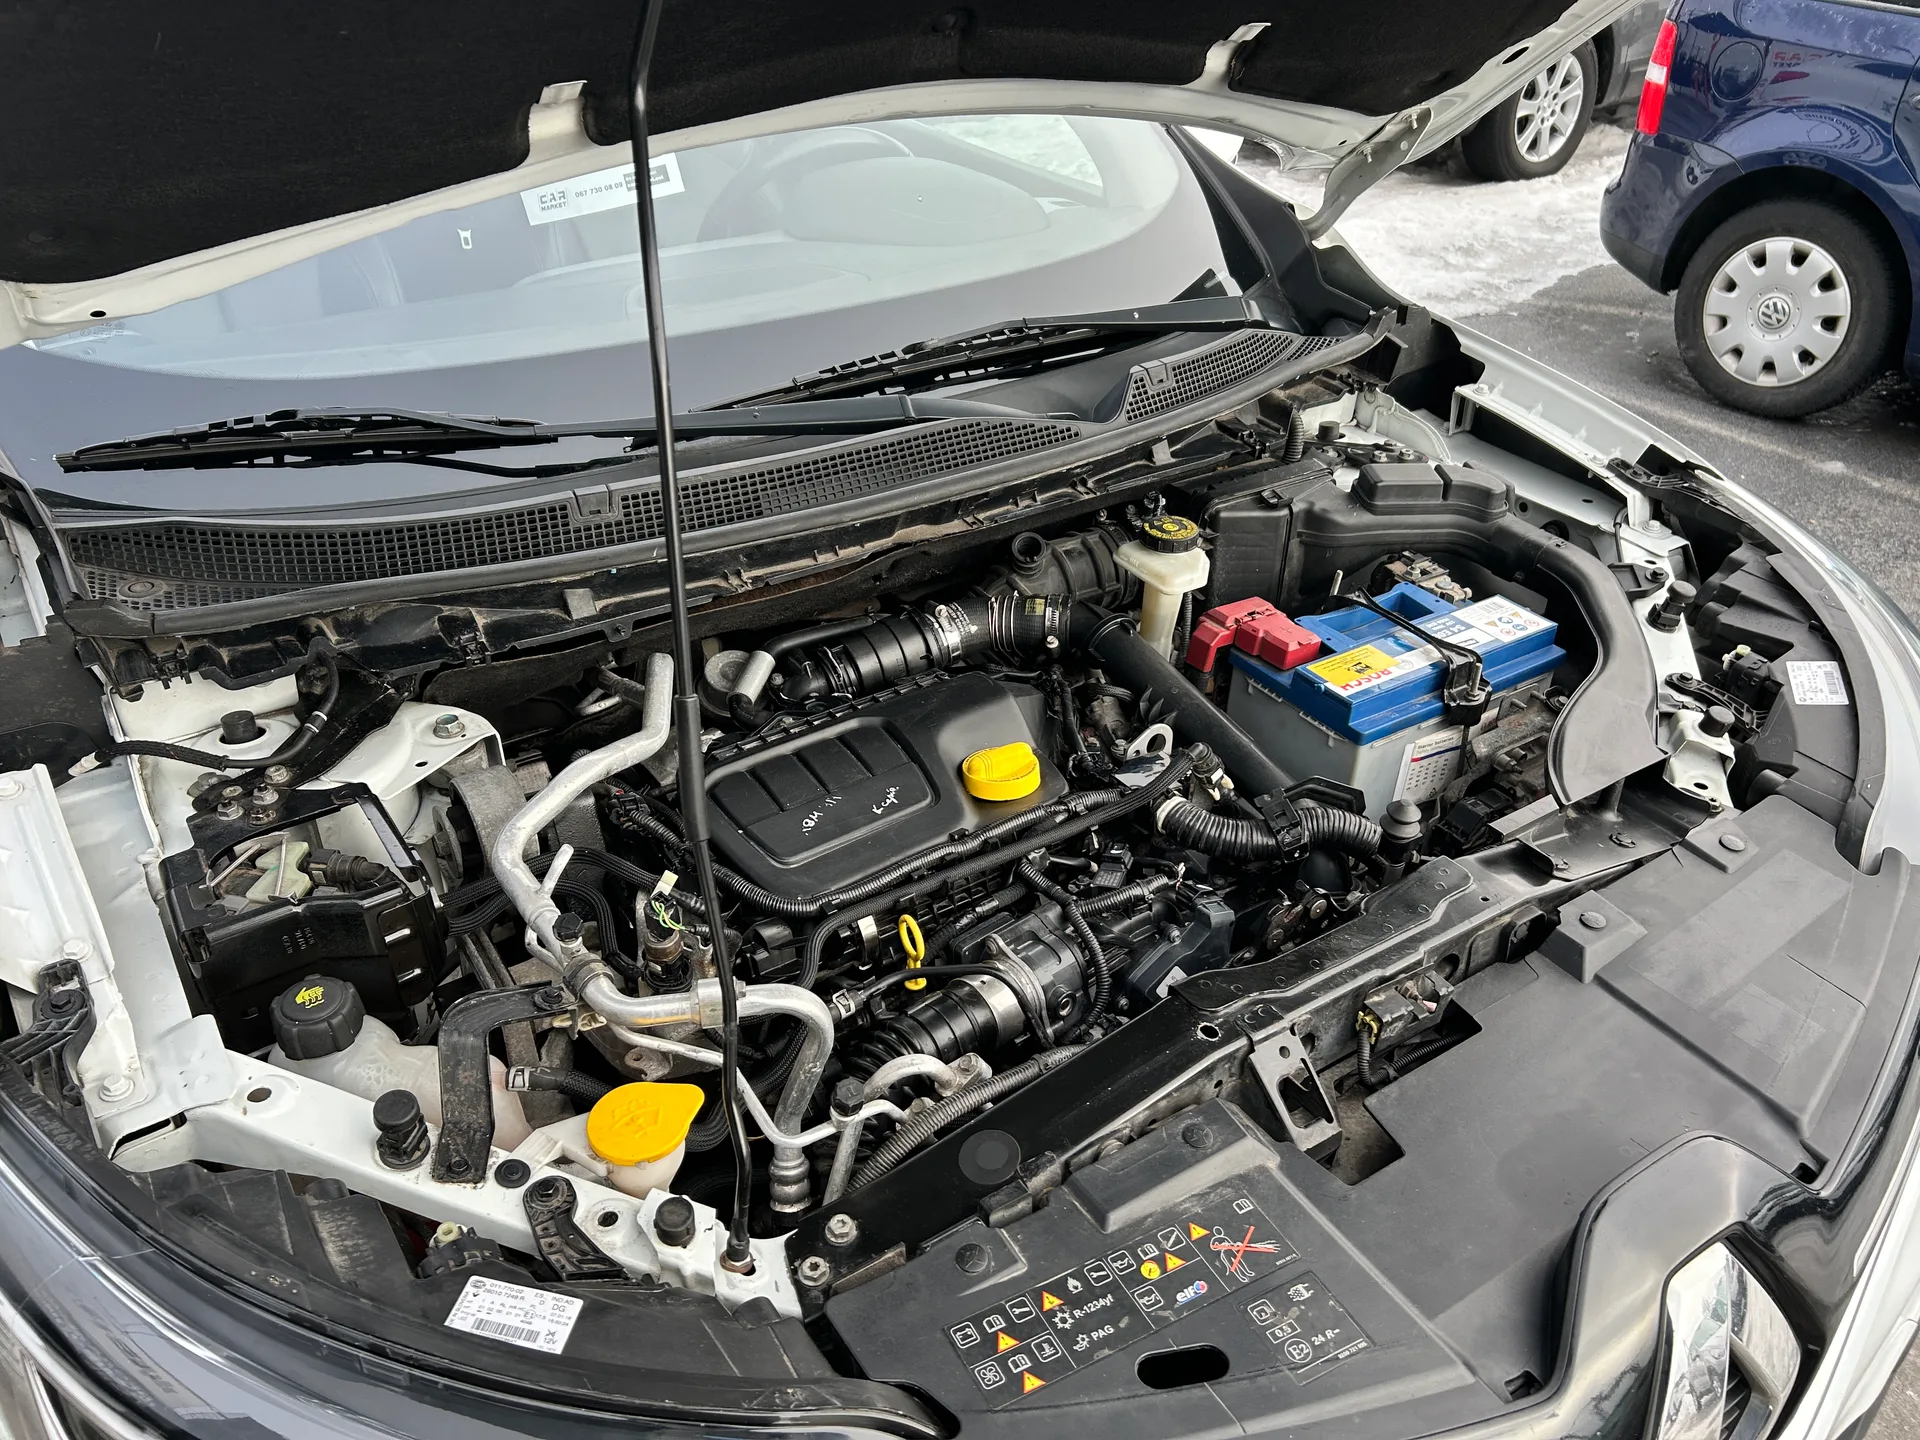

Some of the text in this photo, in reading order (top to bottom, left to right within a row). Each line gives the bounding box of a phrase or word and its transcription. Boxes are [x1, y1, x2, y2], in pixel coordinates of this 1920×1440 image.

[539, 189, 567, 205] CAR
[575, 190, 588, 198] 067
[590, 186, 603, 194] 730
[541, 202, 567, 212] MARKET
[1176, 1286, 1196, 1302] elf
[552, 1304, 566, 1312] DG
[1073, 1294, 1114, 1318] R-1234yf
[1090, 1325, 1115, 1341] PAG
[1275, 1324, 1292, 1338] 0,5
[1311, 1334, 1325, 1346] 24
[1288, 1343, 1310, 1360] E2
